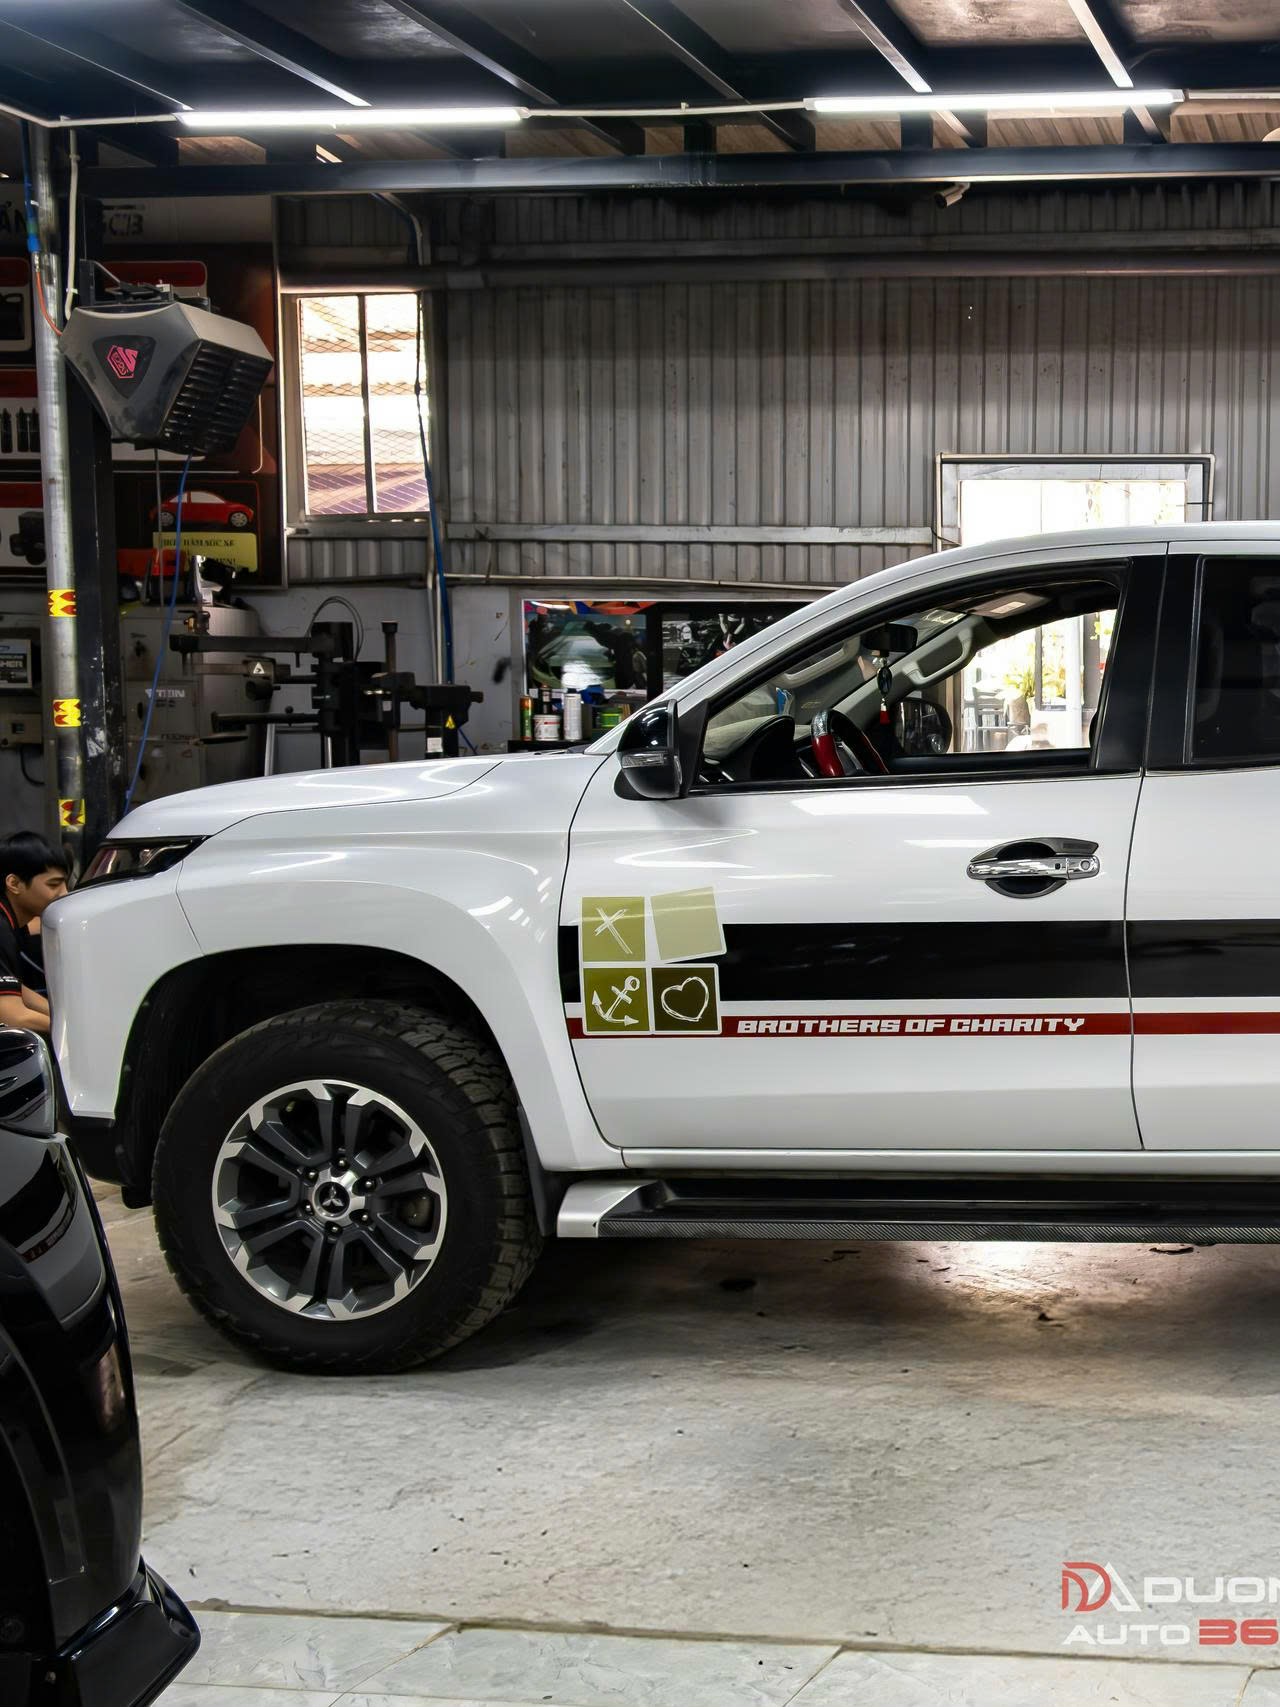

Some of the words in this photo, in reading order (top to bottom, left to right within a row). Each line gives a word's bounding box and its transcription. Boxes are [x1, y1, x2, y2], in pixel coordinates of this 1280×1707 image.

[737, 1019, 901, 1033] BROTHERS
[905, 1018, 945, 1032] OF
[950, 1018, 1085, 1032] CHARITY
